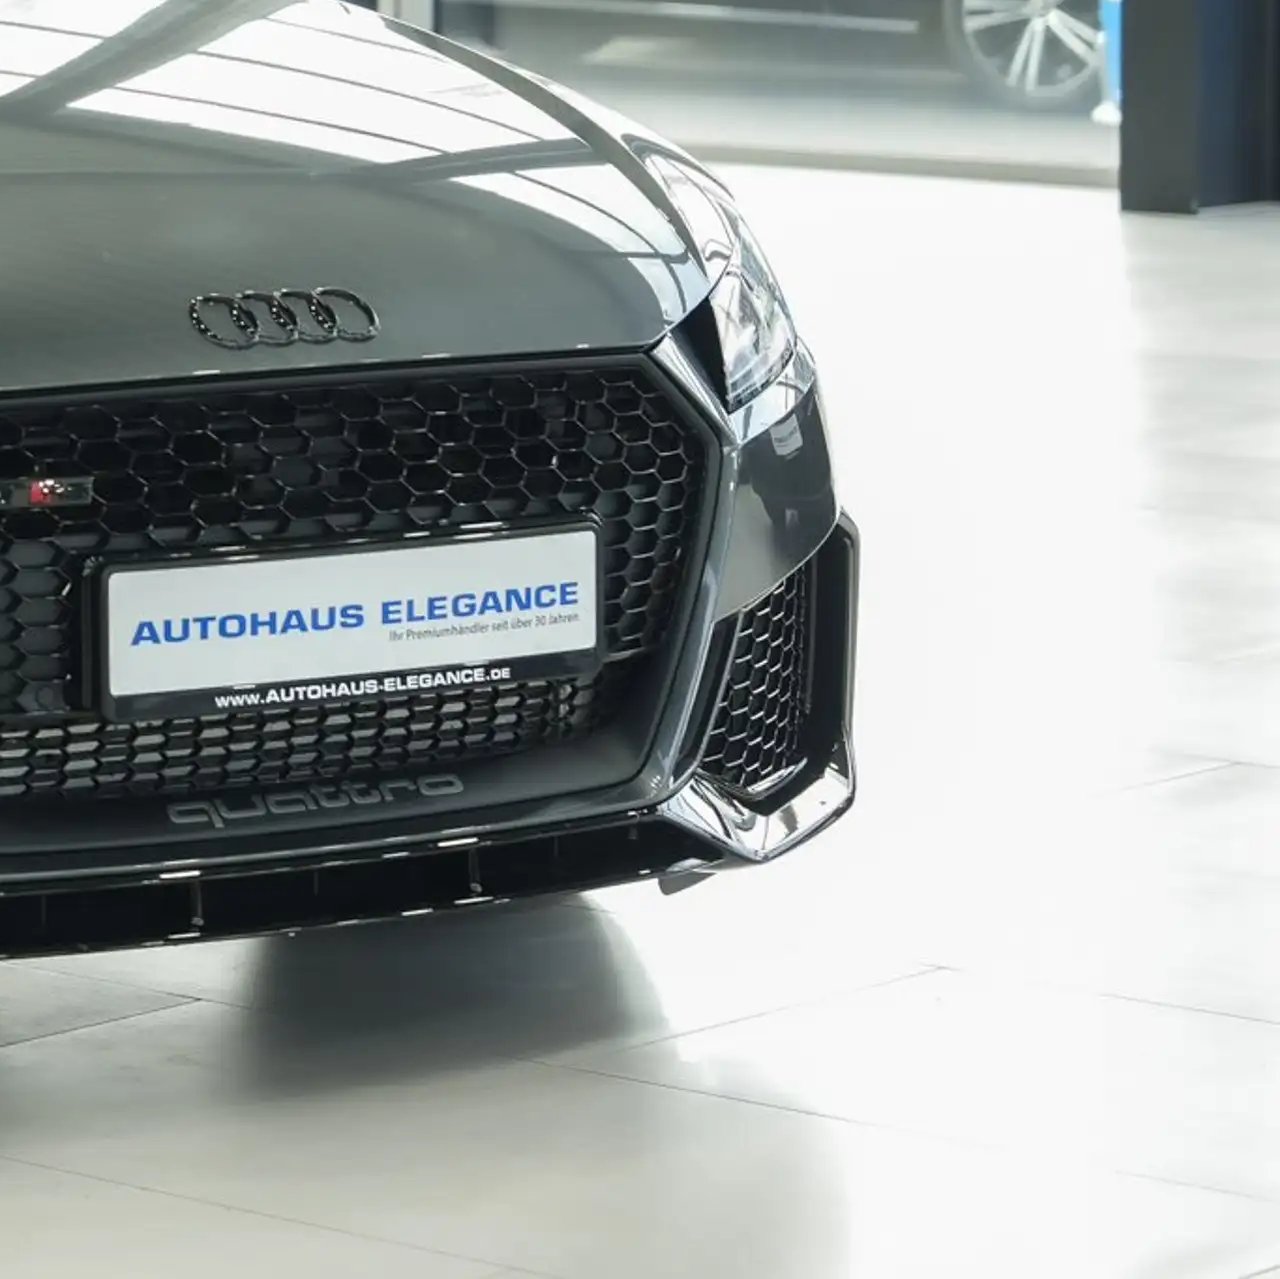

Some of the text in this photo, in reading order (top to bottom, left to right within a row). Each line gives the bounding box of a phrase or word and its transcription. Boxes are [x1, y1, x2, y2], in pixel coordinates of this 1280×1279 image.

[130, 581, 579, 646] AUTOHAUS ELEGANCE
[389, 629, 403, 641] Ihr
[491, 620, 508, 633] seit
[165, 773, 465, 828] quattro
